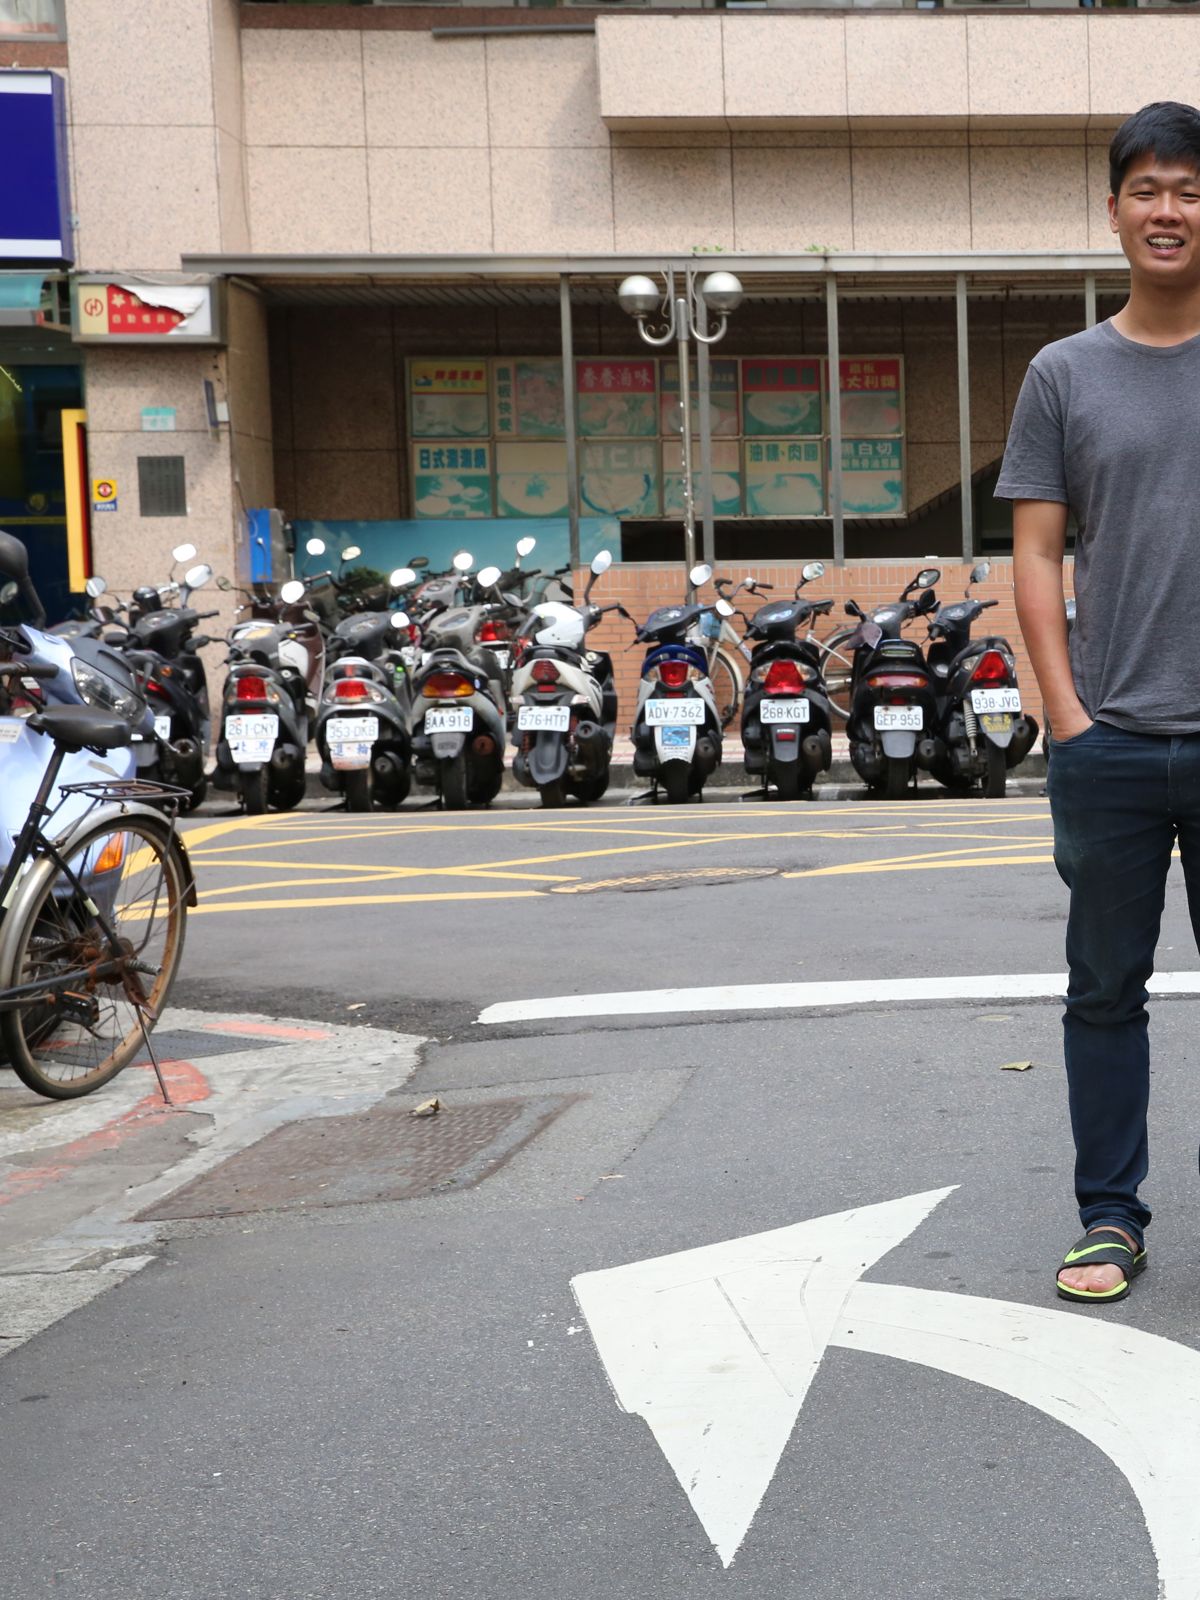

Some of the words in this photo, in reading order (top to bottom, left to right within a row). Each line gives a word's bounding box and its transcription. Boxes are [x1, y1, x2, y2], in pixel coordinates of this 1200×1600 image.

[974, 696, 1020, 709] 938-JVG
[648, 706, 702, 719] ADV-7362
[762, 706, 808, 719] 268-KGT
[520, 714, 567, 727] 576-HTP
[876, 713, 921, 726] GEP-955
